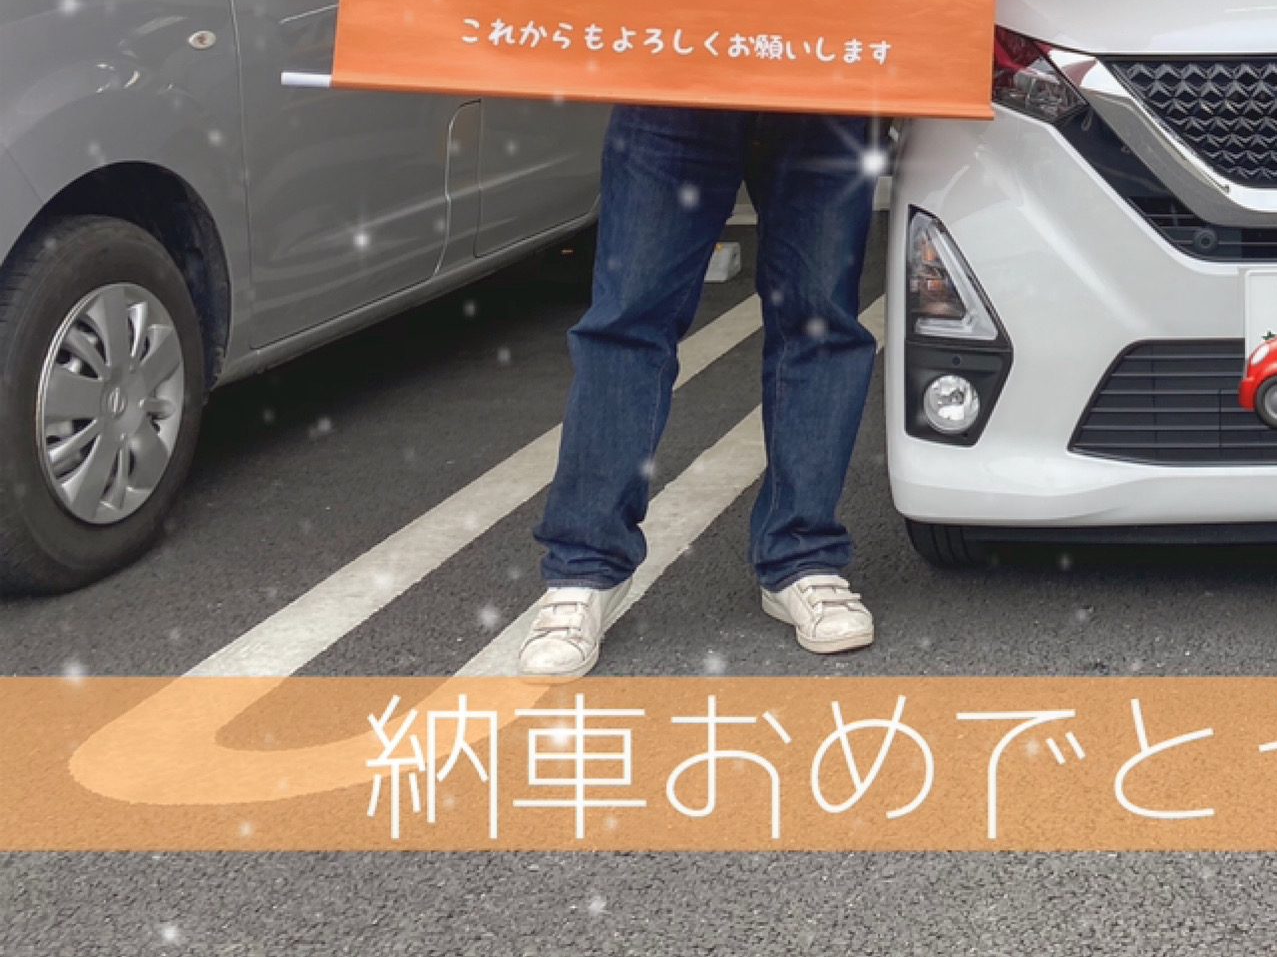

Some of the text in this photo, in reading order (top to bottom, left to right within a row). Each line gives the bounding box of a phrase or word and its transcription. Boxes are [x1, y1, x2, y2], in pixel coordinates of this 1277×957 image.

[461, 17, 892, 65] これからもよろしくお願いします
